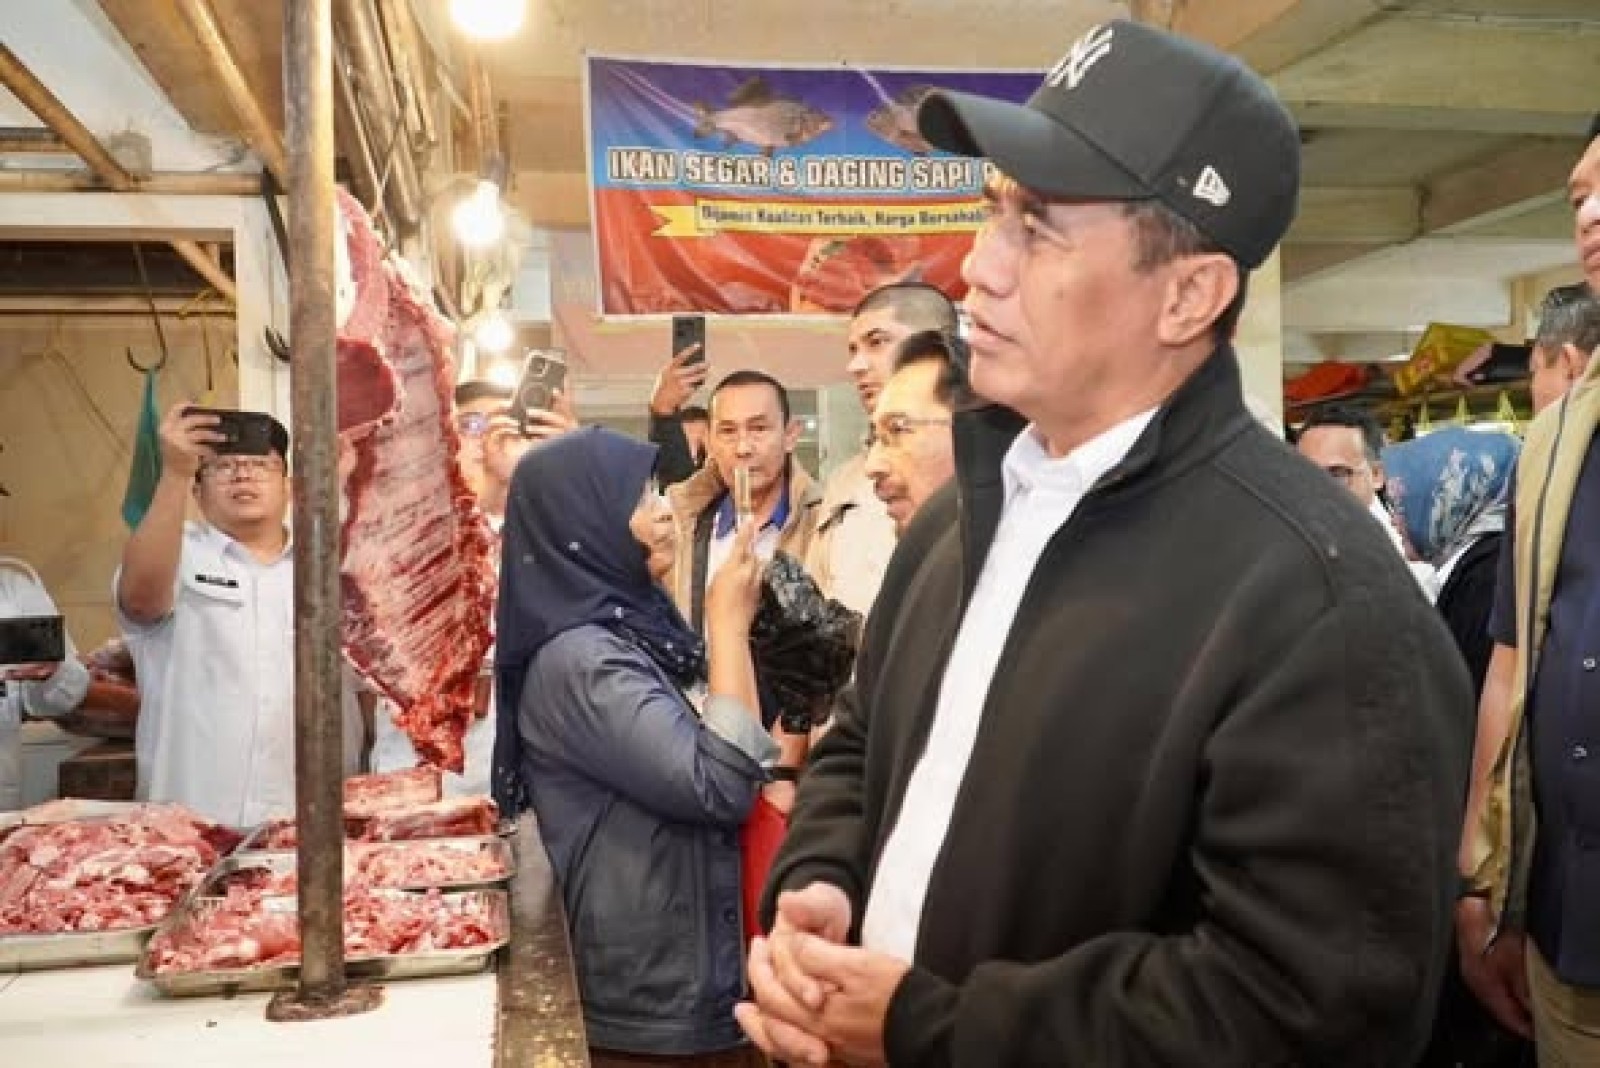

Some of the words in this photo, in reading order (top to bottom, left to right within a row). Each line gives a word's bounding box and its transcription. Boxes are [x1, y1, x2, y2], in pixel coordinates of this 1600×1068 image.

[609, 149, 677, 179] IKAN
[683, 153, 771, 186] SEGAR
[778, 157, 796, 187] &
[804, 157, 904, 188] DAGING
[912, 158, 974, 189] SAPI
